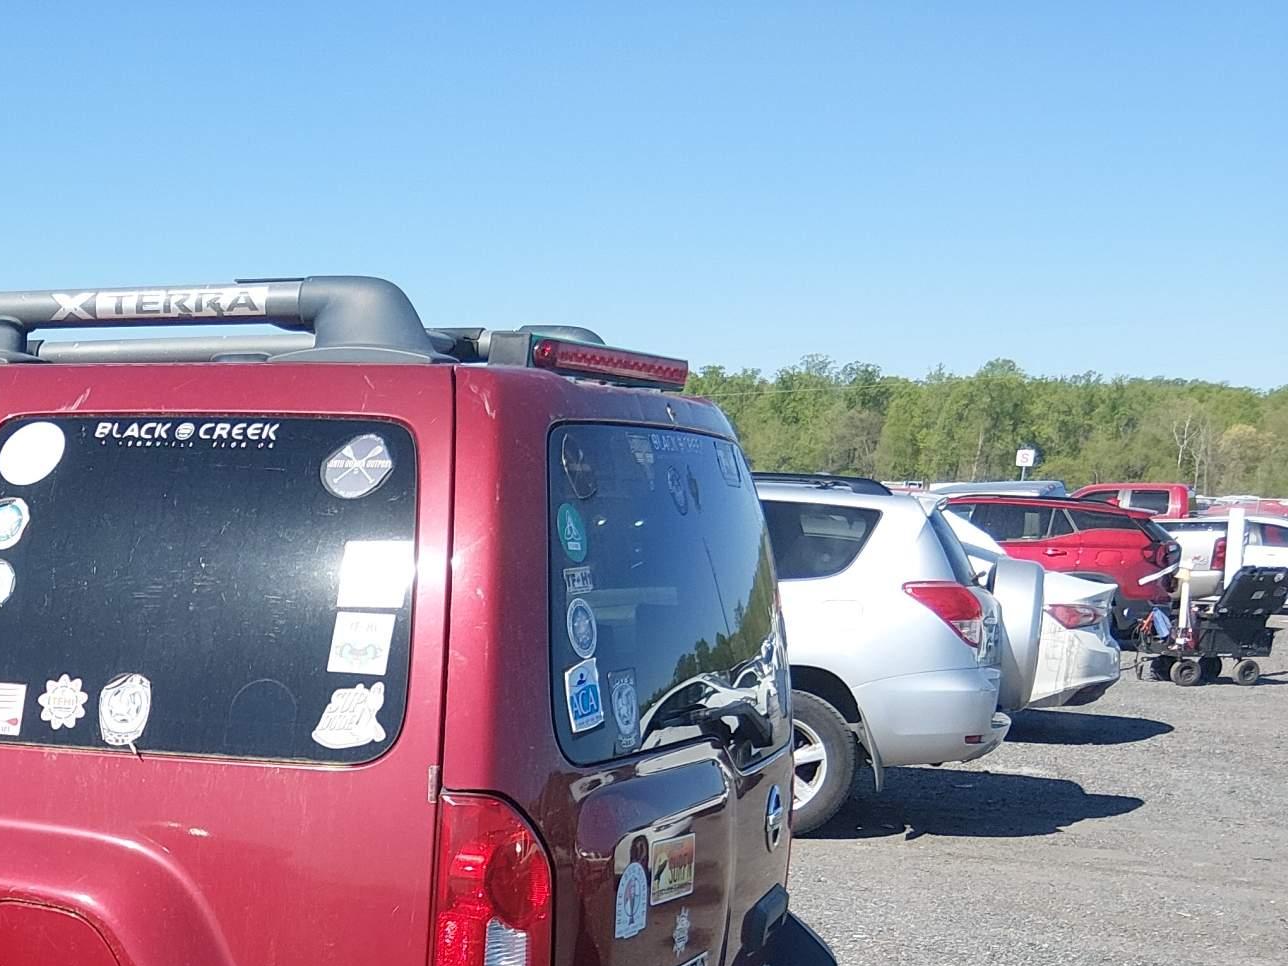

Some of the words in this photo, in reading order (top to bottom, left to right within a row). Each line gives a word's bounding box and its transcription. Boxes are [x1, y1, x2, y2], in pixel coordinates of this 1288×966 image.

[50, 288, 267, 320] XTERRA
[94, 422, 172, 438] BLACK
[198, 423, 280, 440] CREEK
[1020, 453, 1030, 464] S
[572, 687, 597, 718] ACA
